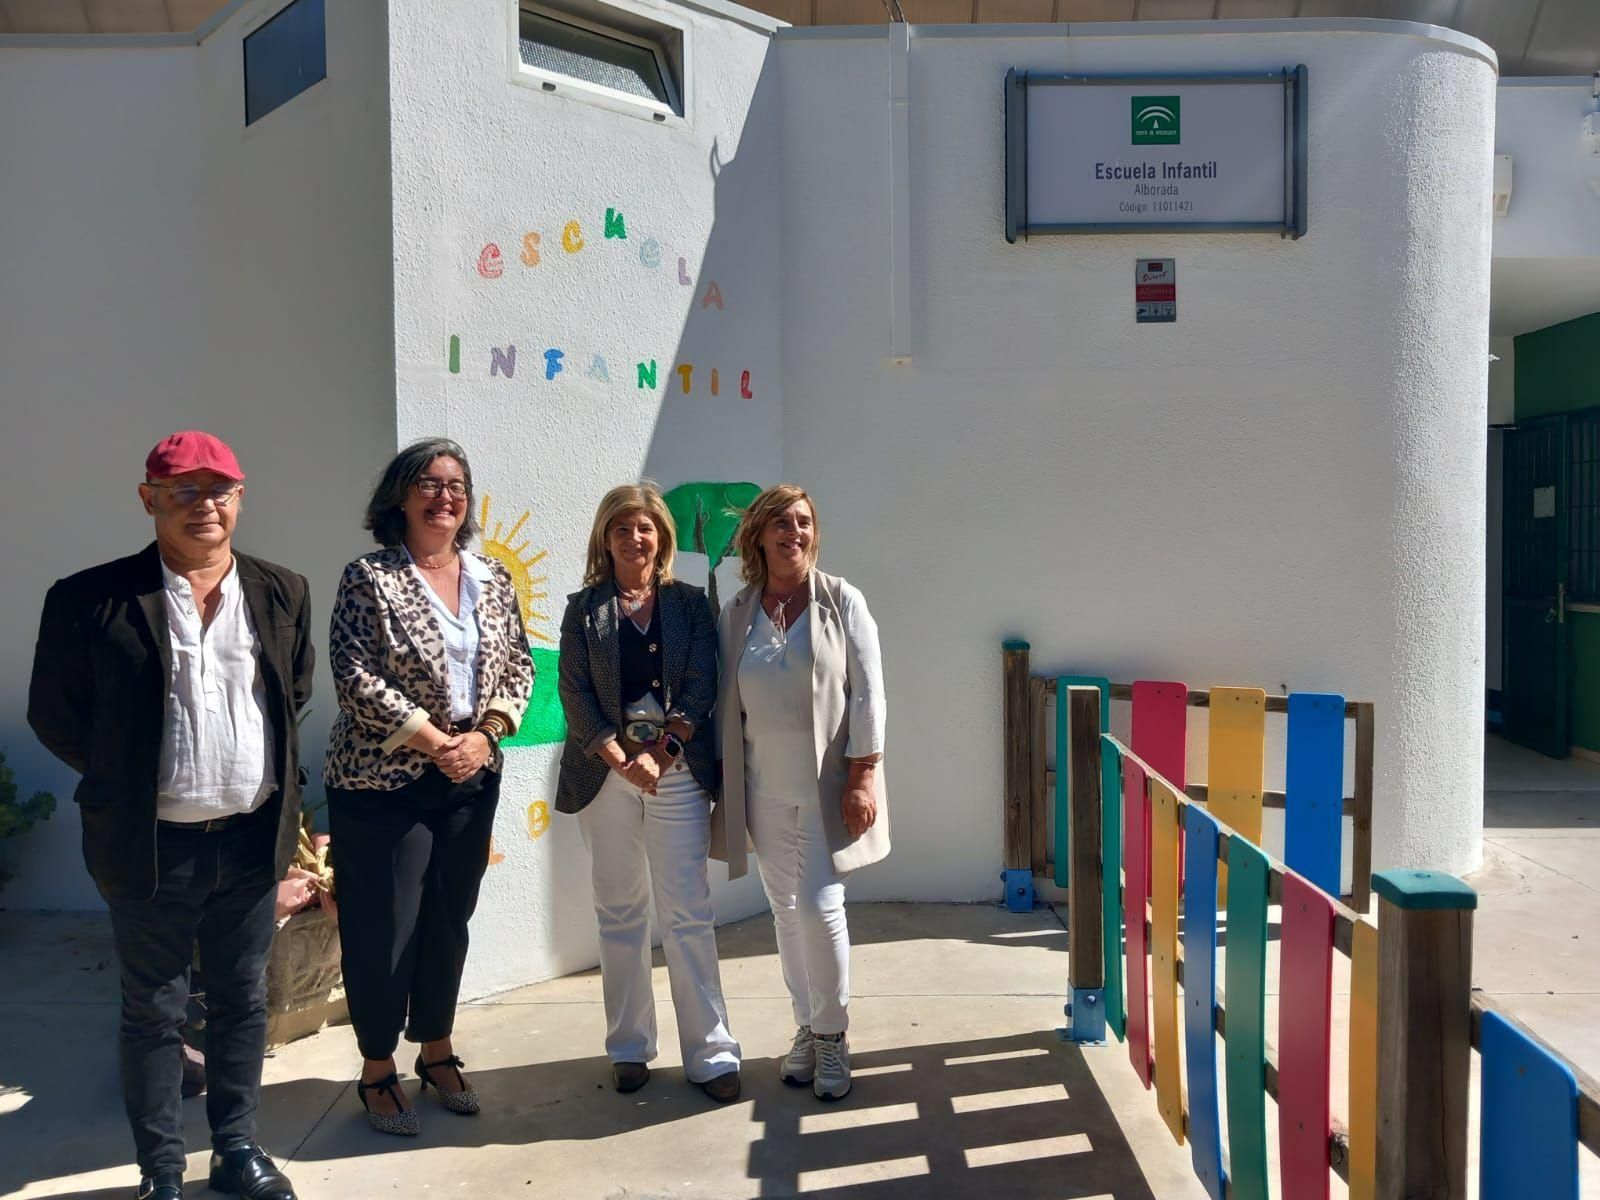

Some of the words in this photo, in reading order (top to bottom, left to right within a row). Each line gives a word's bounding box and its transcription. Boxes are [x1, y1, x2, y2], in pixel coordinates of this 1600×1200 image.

[1095, 162, 1156, 180] Escuela
[1163, 161, 1217, 179] Infantil
[1134, 183, 1179, 196] Alborada
[1119, 201, 1149, 214] Código:
[449, 334, 753, 399] INFANTIL
